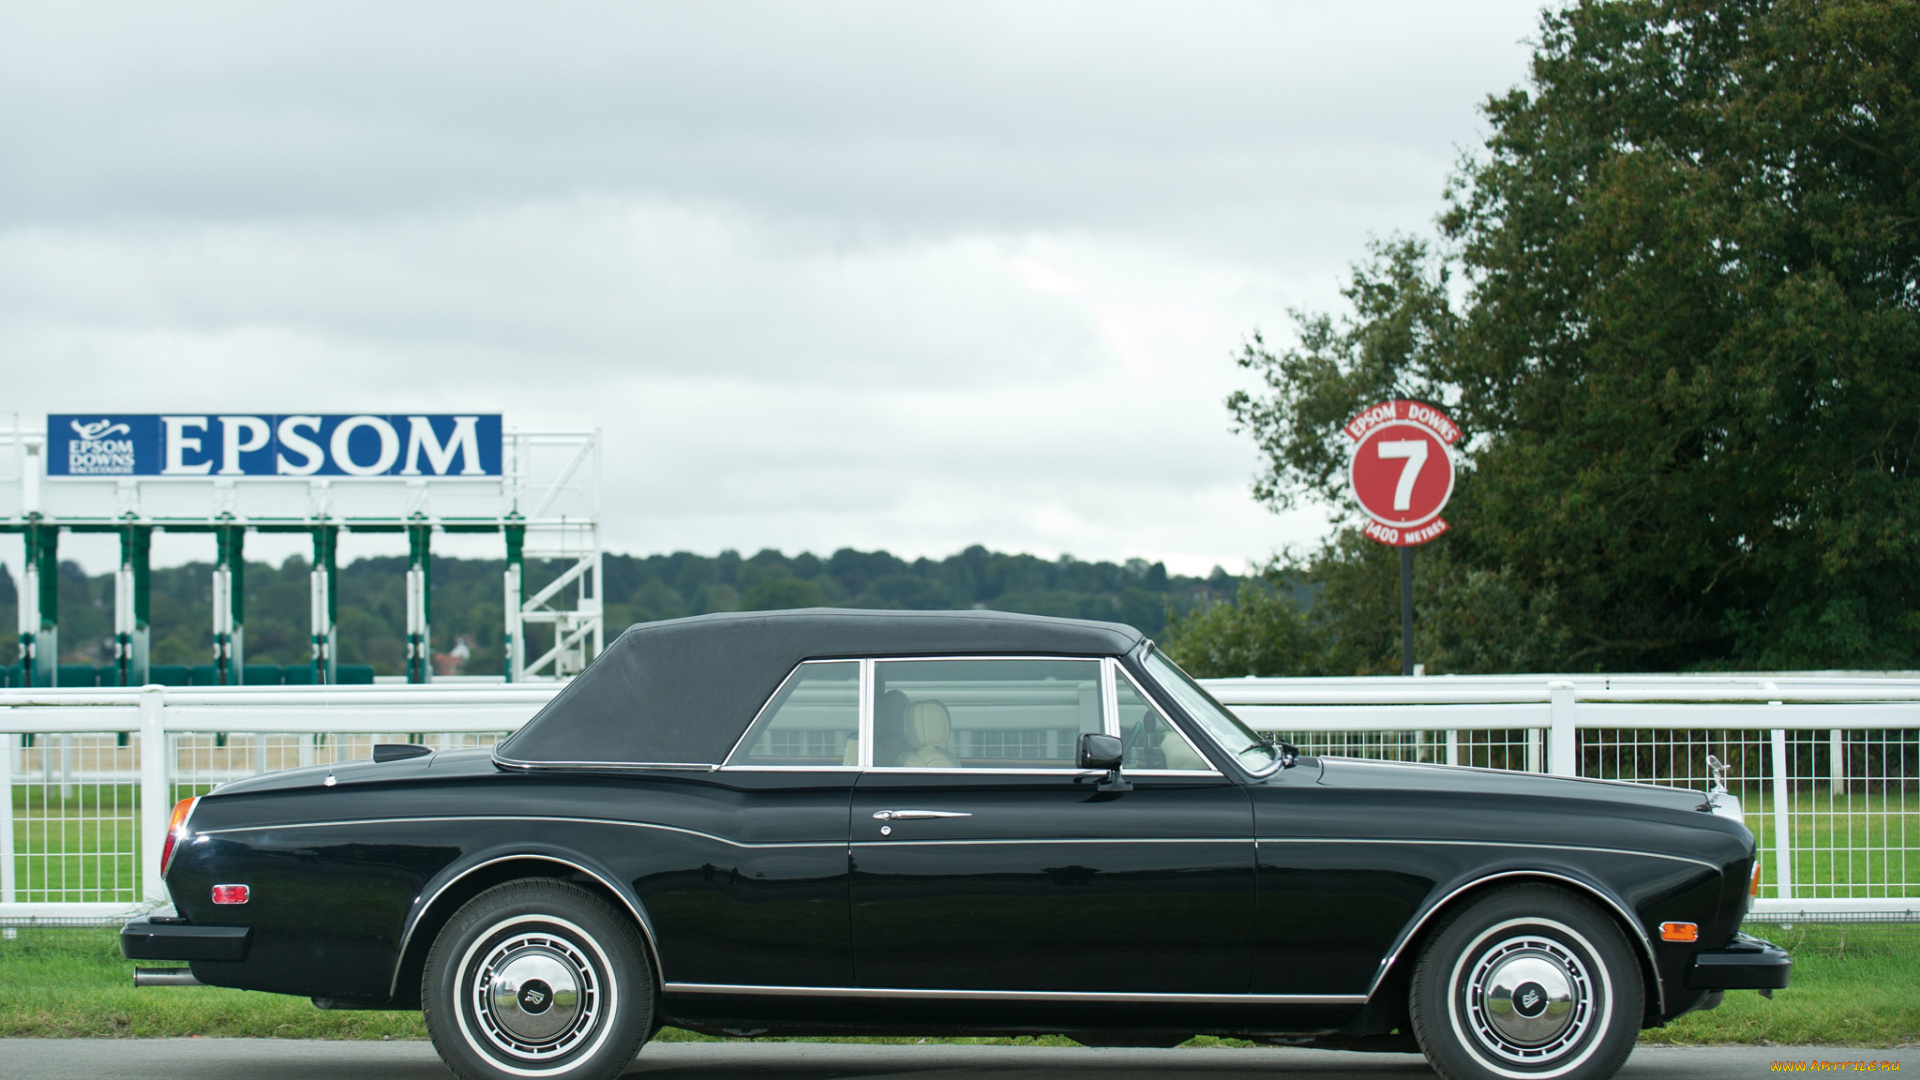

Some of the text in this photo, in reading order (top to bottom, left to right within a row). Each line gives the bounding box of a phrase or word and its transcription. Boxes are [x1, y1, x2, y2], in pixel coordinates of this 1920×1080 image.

[1349, 401, 1458, 442] EPSOM DOWNS
[69, 439, 133, 454] EPSOM
[69, 453, 135, 467] DOWNS
[161, 416, 486, 476] EPSOM
[1378, 440, 1428, 511] 7
[1366, 519, 1446, 544] 1400 METRES
